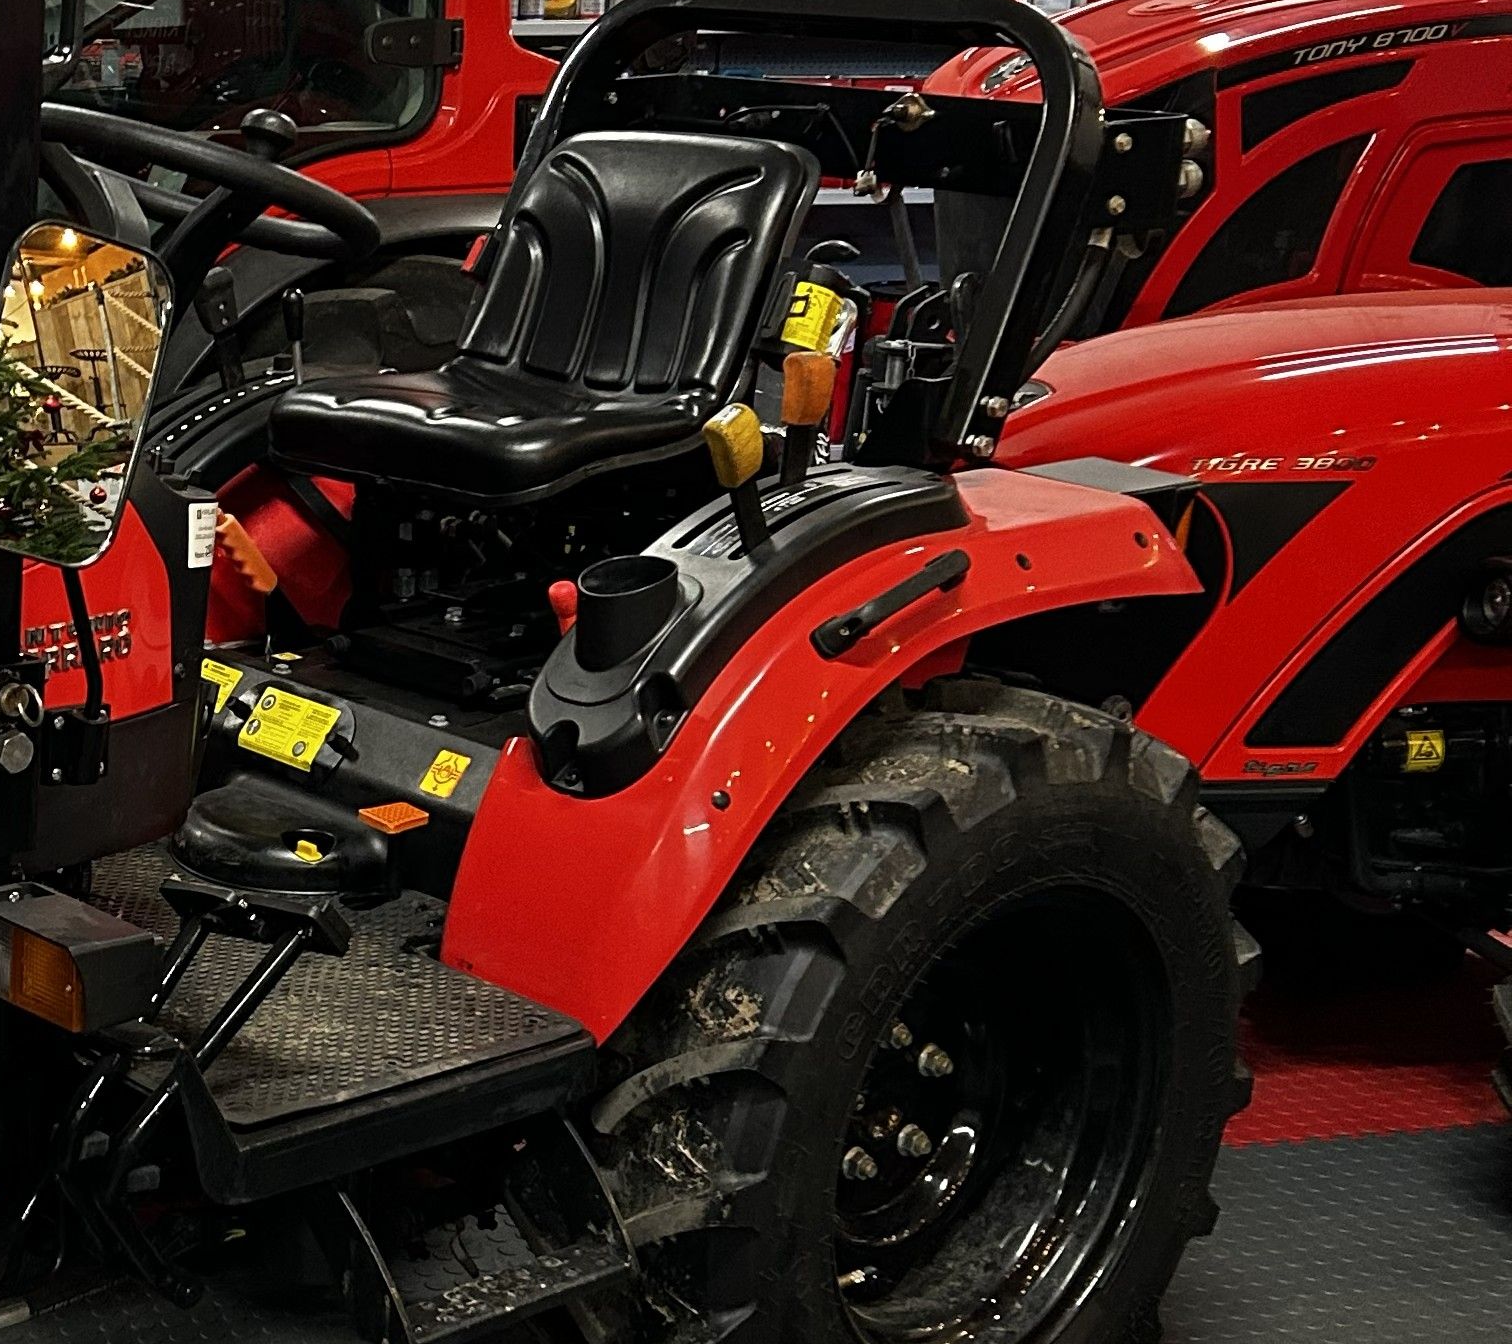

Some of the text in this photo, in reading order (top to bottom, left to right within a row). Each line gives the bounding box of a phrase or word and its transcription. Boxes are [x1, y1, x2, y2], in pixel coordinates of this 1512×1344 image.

[1292, 36, 1368, 65] TONY
[1372, 24, 1449, 48] 8700
[1192, 455, 1378, 472] TIGRE 3800
